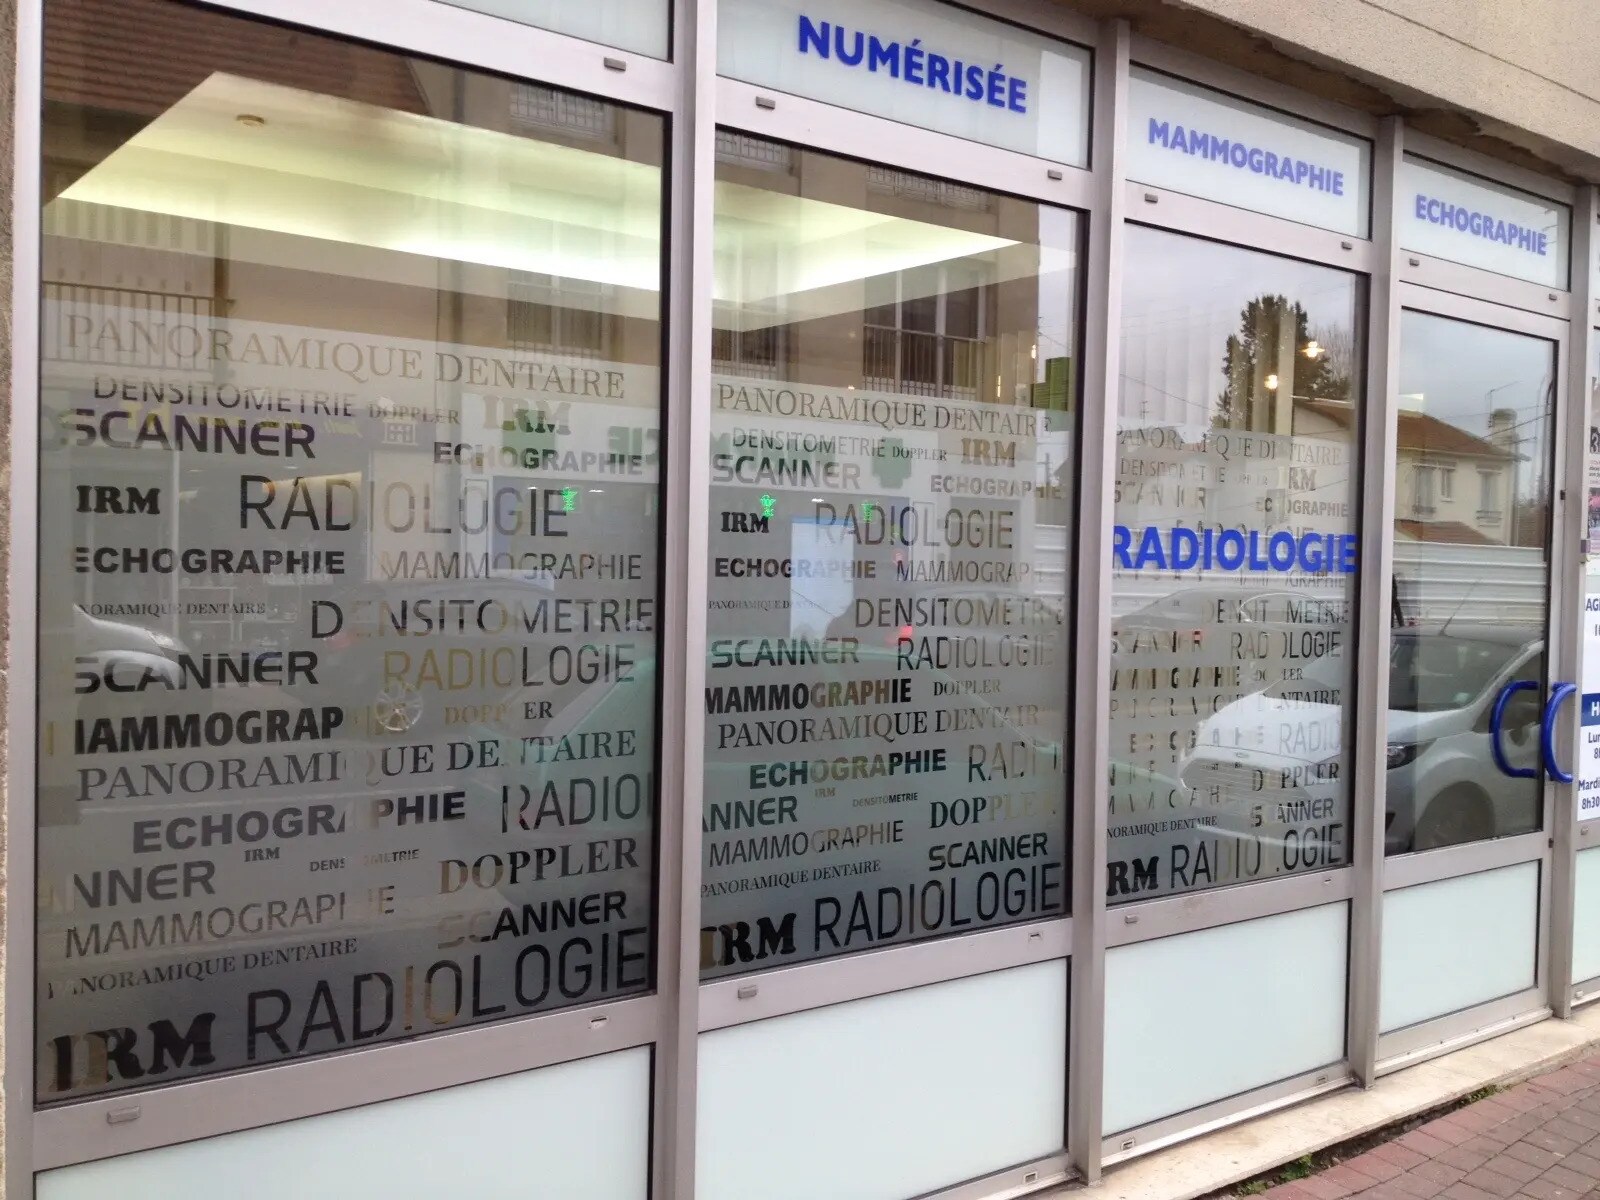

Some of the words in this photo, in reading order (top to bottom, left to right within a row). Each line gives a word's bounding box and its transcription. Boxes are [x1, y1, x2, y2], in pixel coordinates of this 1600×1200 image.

[799, 14, 1027, 114] NUMÉRISÉE
[1148, 117, 1344, 196] MAMMOGRAPHIE
[1415, 194, 1547, 257] ECHOGRAPHIE
[66, 313, 422, 384] PANORAMIQUE
[436, 352, 625, 399] DENTAIRE
[94, 375, 358, 418] DENSITOMETRIE
[369, 402, 459, 425] DOPPLER
[716, 383, 927, 429] PANORAMIQUE
[60, 408, 315, 458] SCANNER
[732, 427, 886, 458] DENSITOMETRIE
[892, 445, 948, 461] DOPPLER
[960, 437, 1016, 468] IRM
[712, 454, 861, 490] SCANNER
[76, 485, 160, 515] IRM
[240, 474, 568, 538] RADIOLOGIE
[720, 511, 770, 533] IRM
[814, 502, 1014, 551] RADIOLOGIE
[75, 546, 345, 574] ECHOGRAPHIE
[381, 551, 642, 580] MAMMOGRAPHIE
[714, 557, 877, 580] ECHOGRAPHIE
[1113, 525, 1358, 574] RADIOLOGIE
[186, 602, 266, 615] DENTAIRE
[711, 637, 860, 669] SCANNER
[1231, 630, 1342, 659] RADOLOGIE
[75, 651, 319, 694] SCANNER
[384, 644, 635, 693] RADIOLOGIE
[933, 678, 1001, 697] DOPPLER
[444, 701, 554, 726] DOPPER
[704, 678, 912, 715] MAMMOGRAPHIE
[718, 711, 928, 749] PANORAMIQUE
[749, 748, 947, 789] ECHOGRAPHIE
[502, 774, 650, 833] RADIO
[814, 787, 836, 799] IRM
[852, 792, 919, 808] DENSITOMETRIE
[930, 791, 1056, 829] DOPPLE
[1251, 798, 1335, 828] SANNER
[133, 791, 466, 854] ECHOGRPHIE
[244, 847, 281, 863] IRM
[709, 820, 904, 868] MAMMOGRAPHIE
[928, 832, 1048, 872] SCANNER
[1171, 824, 1344, 889] RADIOOGIE
[438, 837, 639, 895] DOPPLER
[700, 870, 809, 899] PANORAMIQUE
[812, 858, 881, 881] DENTAIRE
[437, 890, 627, 950] SCANNER
[700, 912, 797, 971] IRM
[814, 862, 1062, 952] RADIOLOGIE
[47, 956, 235, 999] NORAMIQUE
[243, 938, 358, 970] DENTAIRE
[47, 1012, 217, 1094] IRM
[247, 926, 648, 1061] RADIOLOGIE
